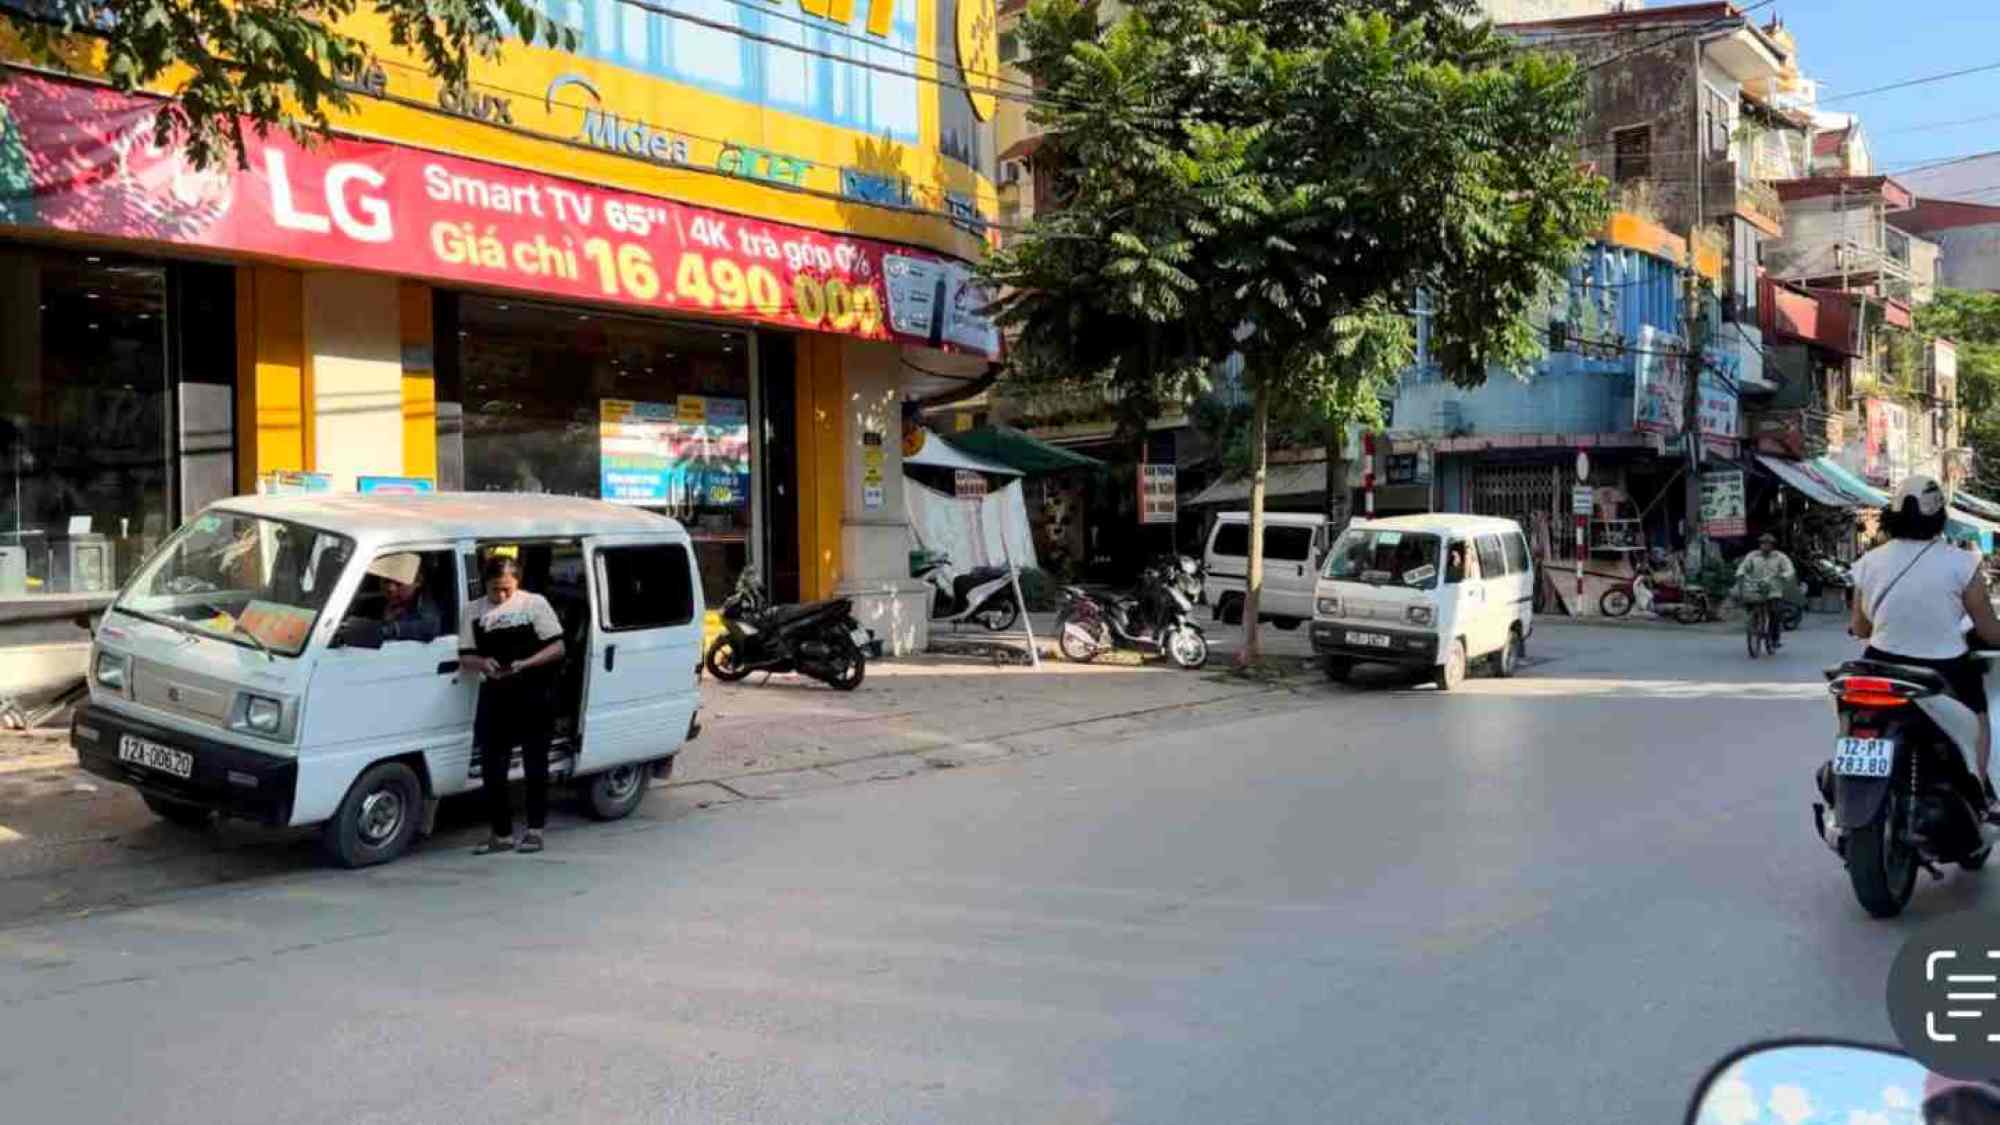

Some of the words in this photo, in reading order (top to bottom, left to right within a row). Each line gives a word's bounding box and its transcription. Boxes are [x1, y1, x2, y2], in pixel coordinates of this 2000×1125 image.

[582, 107, 689, 166] Midea
[263, 147, 394, 243] LG
[423, 163, 545, 218] Smart
[546, 186, 594, 225] TV
[690, 216, 731, 250] 4K
[782, 235, 833, 272] góp
[431, 220, 508, 272] Giá
